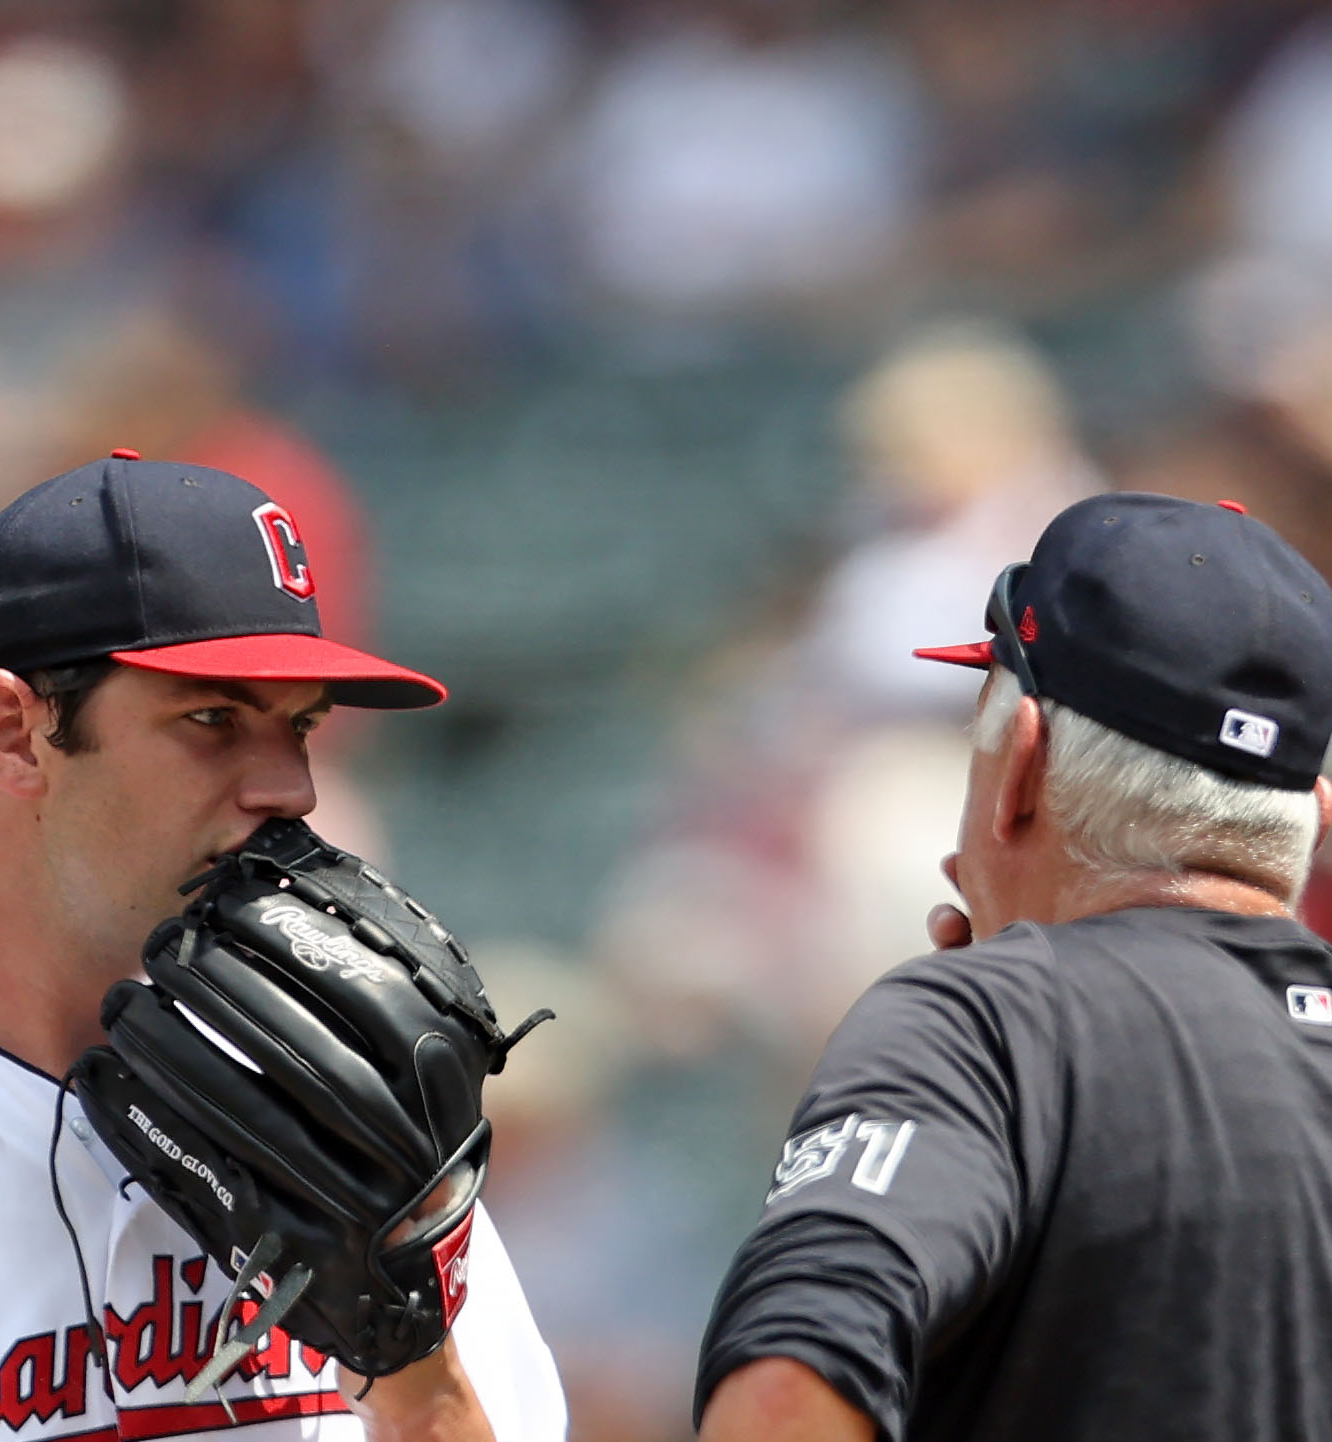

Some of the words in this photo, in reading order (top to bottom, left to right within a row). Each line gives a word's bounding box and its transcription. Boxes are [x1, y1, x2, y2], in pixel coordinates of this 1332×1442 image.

[259, 905, 385, 984] Rawlings
[126, 1103, 153, 1134] THE
[148, 1127, 182, 1161] GOLD
